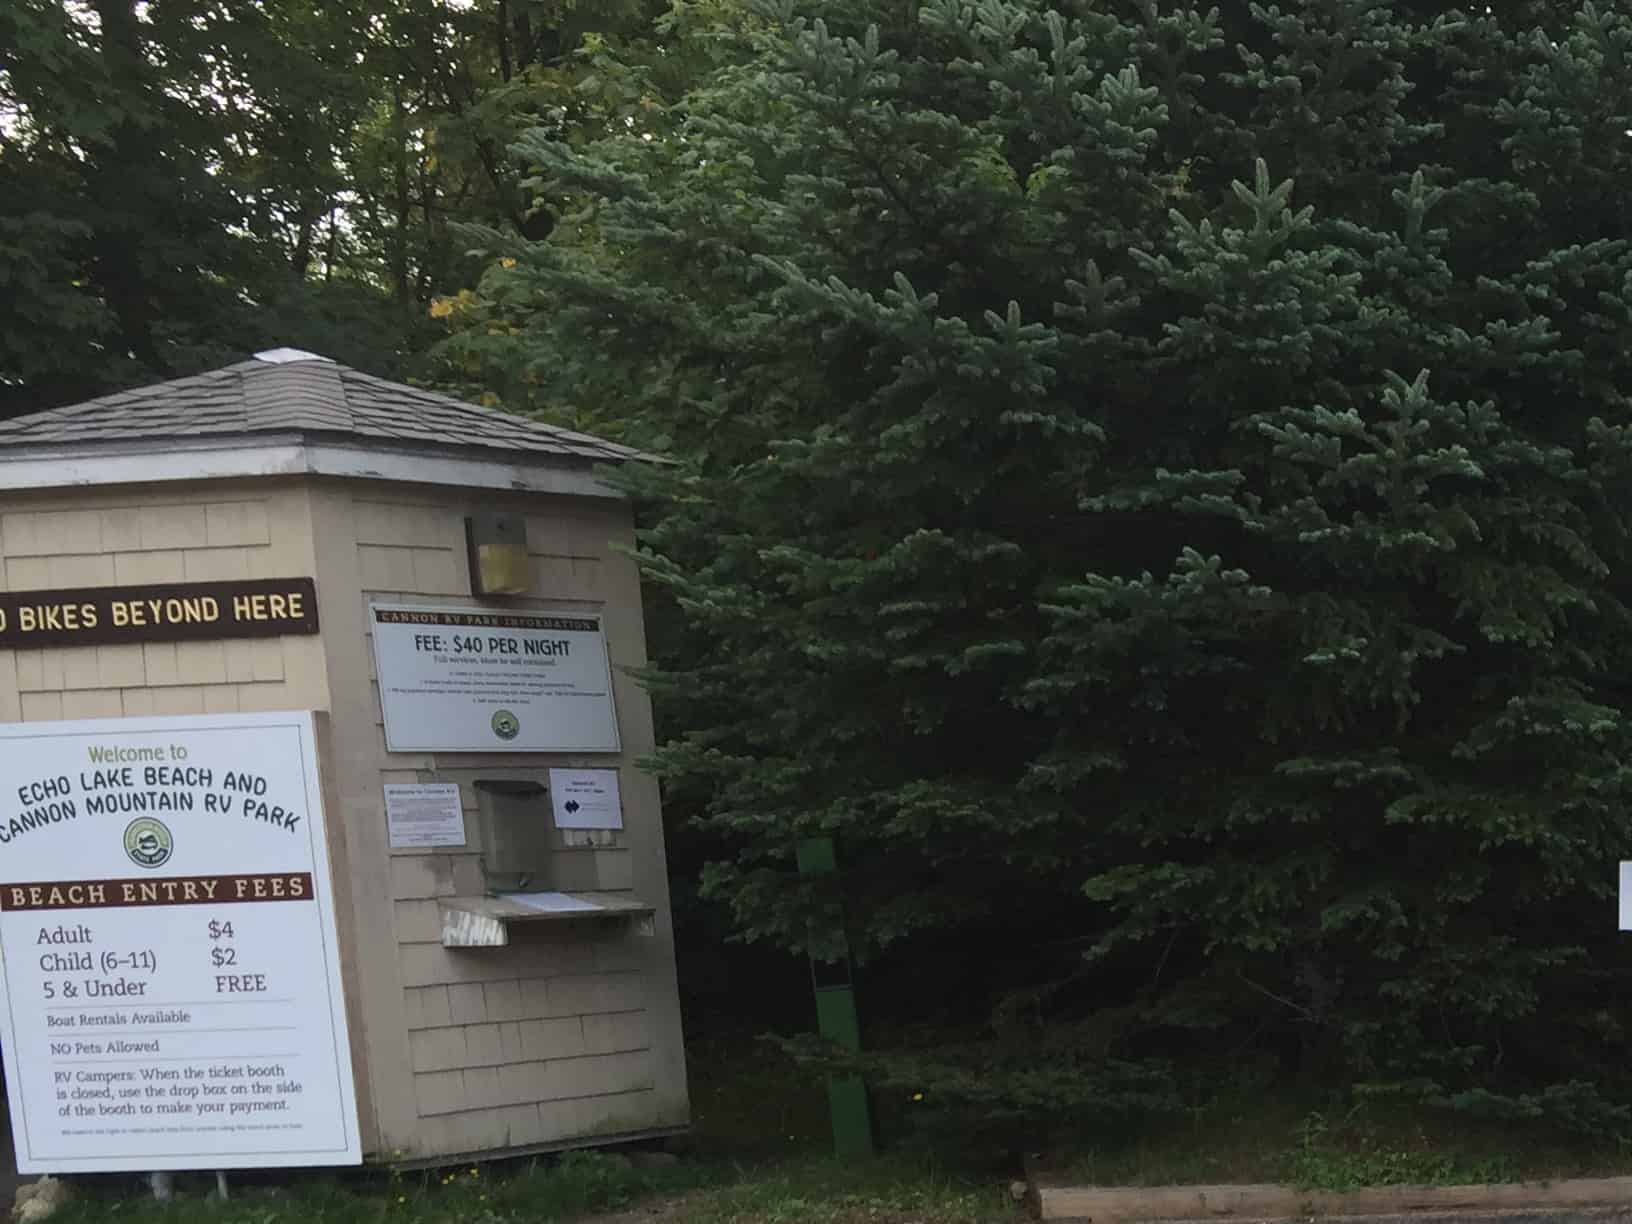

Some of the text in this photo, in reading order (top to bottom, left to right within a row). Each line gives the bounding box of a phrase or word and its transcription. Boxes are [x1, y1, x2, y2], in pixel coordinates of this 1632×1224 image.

[19, 603, 98, 632] BIKES
[111, 596, 220, 627] BEYOND
[233, 593, 305, 621] HERE
[414, 634, 571, 657] FEE: $40 PER NIGHT
[88, 743, 188, 764] Welcome to
[18, 767, 267, 806] ECHO LAKE BEACH AND
[0, 791, 301, 843] CANNON MOUNTAIN RV PARK
[11, 877, 304, 907] BEACH ENTRY FEES
[37, 918, 235, 945] Adult $4
[40, 952, 93, 972] Child
[211, 947, 237, 968] $2
[43, 974, 267, 998] 5 & Under FREE
[47, 1010, 191, 1027] Boat Rentals Available
[50, 1040, 160, 1055] NO Pets Allowed
[54, 1071, 72, 1083] RV
[139, 1067, 180, 1081] When
[184, 1066, 205, 1079] the
[208, 1065, 244, 1078] ticket
[247, 1064, 285, 1078] booth
[56, 1081, 303, 1101] is closed, use the drop box on the side
[58, 1099, 290, 1117] of the booth to make your payment.
